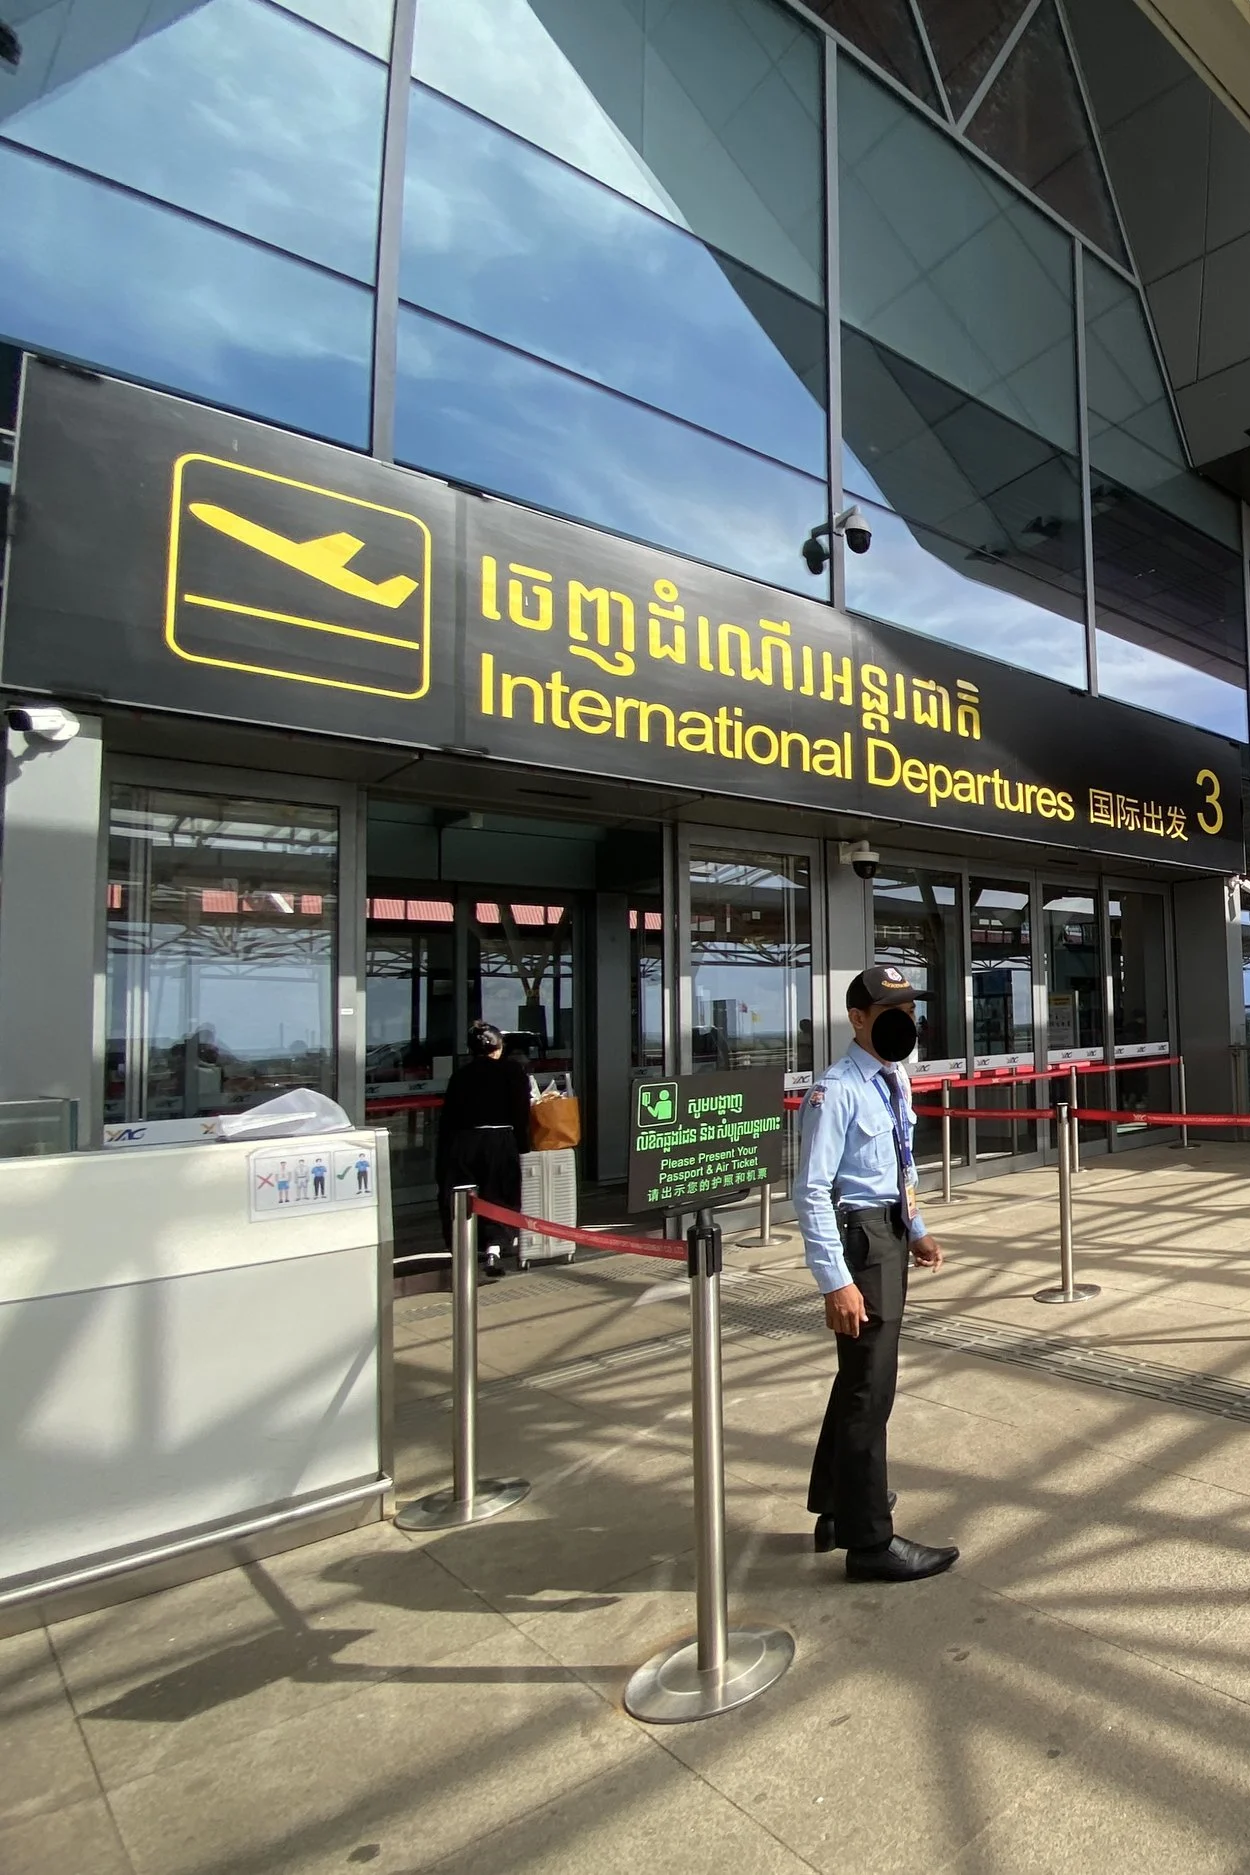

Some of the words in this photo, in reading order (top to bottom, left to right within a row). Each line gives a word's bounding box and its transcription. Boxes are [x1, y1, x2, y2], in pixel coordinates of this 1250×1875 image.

[481, 652, 853, 780] International
[866, 736, 1075, 822] Departures
[1089, 787, 1189, 842] 国际出发
[1196, 768, 1224, 835] 3
[659, 1167, 704, 1184] Passport
[706, 1165, 714, 1175] &
[716, 1161, 730, 1173] Air
[731, 1156, 759, 1169] Ticket
[660, 1155, 696, 1171] Please
[698, 1149, 736, 1165] Present
[737, 1145, 759, 1157] Your
[647, 1167, 769, 1203] 请出示您的护照和机票
